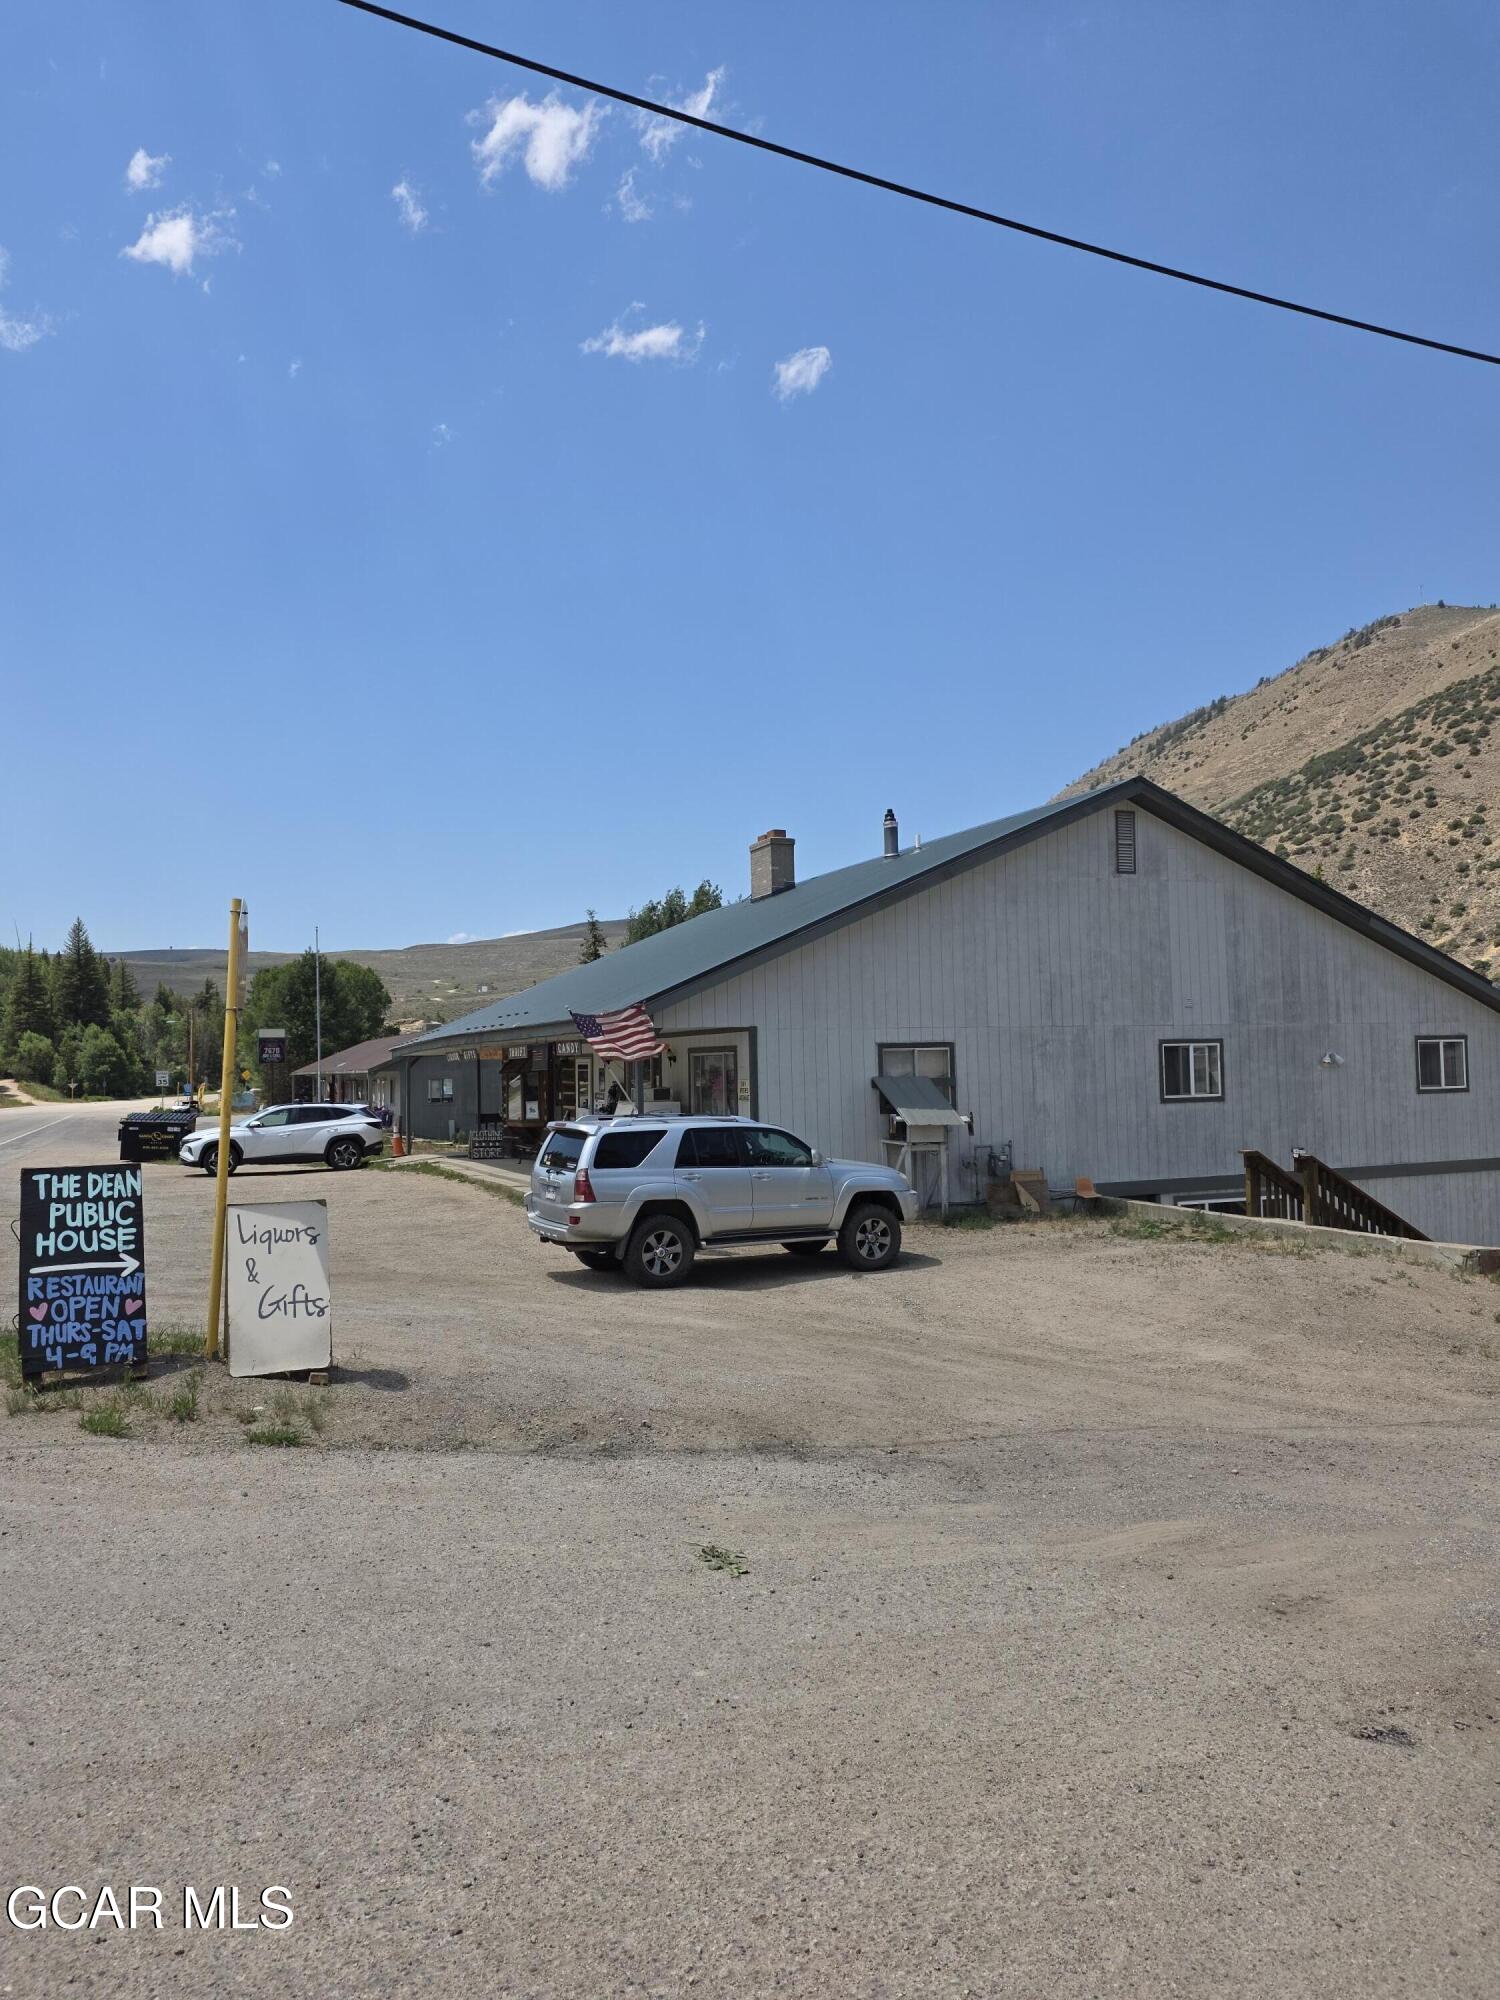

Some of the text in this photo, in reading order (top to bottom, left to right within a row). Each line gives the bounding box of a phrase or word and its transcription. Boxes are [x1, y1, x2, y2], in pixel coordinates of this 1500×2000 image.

[557, 1042, 579, 1054] CANDY
[471, 1130, 503, 1141] CLOTHING
[472, 1147, 503, 1159] STORE
[31, 1169, 142, 1200] THE DEAN
[49, 1201, 135, 1229] PUBLIC
[36, 1227, 138, 1256] HOUSE
[236, 1214, 321, 1255] Liquors
[245, 1257, 260, 1284] &
[27, 1273, 145, 1301] RESTAURANT
[51, 1296, 122, 1322] OPEN
[257, 1284, 329, 1320] Gifts
[27, 1319, 147, 1348] THURS-SAT
[104, 1342, 134, 1362] PM
